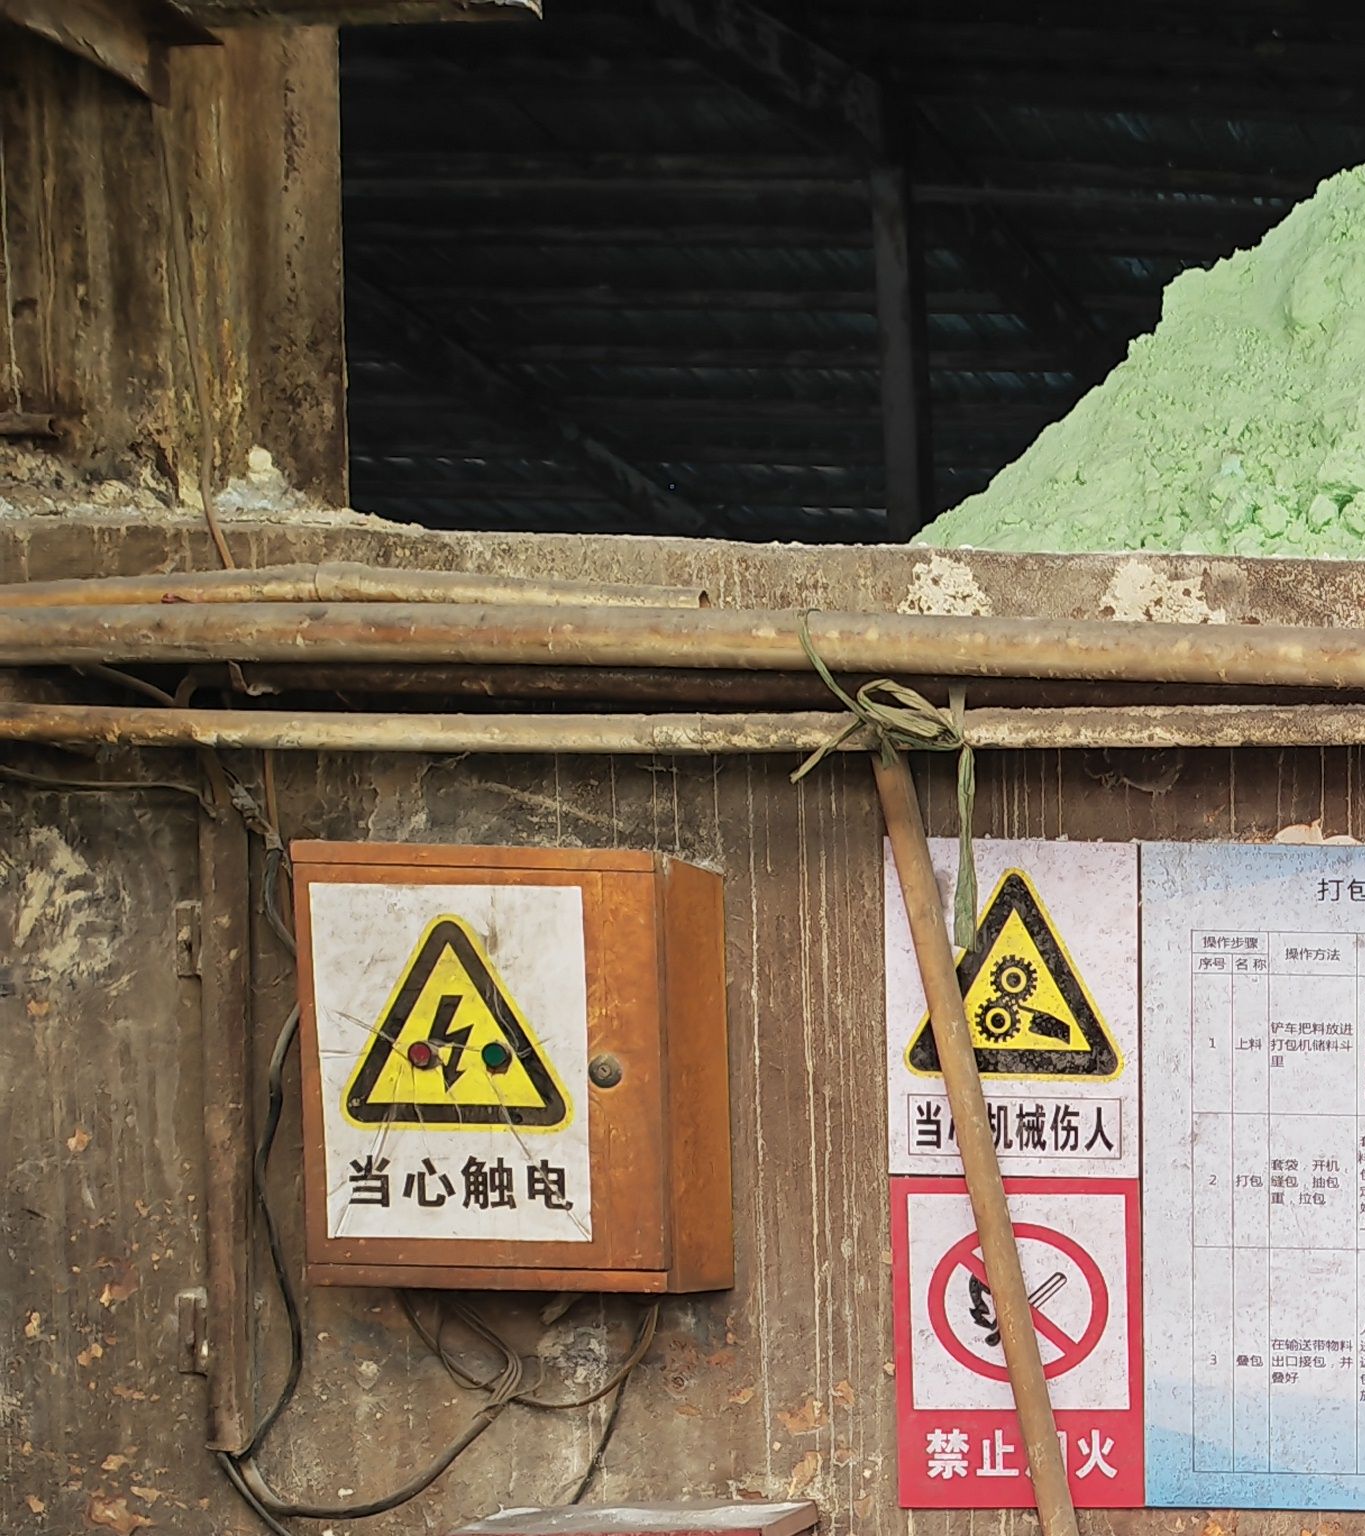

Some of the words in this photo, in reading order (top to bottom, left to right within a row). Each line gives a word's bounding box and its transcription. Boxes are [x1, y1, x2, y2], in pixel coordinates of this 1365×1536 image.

[1203, 936, 1258, 949] 操作步骤
[1285, 948, 1341, 961] 操作方法
[1199, 957, 1225, 970] 序号
[1271, 1022, 1353, 1036] 铲车把料放进
[1209, 1037, 1216, 1049] 1
[1235, 1037, 1262, 1050] 上料
[1271, 1039, 1353, 1052] 打包机储料斗
[1271, 1056, 1285, 1068] 里
[916, 1101, 1114, 1151] 当机械伤人
[349, 1155, 574, 1210] 当心触电
[1209, 1175, 1217, 1186] 2
[1236, 1174, 1263, 1188] 打包
[1271, 1338, 1353, 1351] 在输送带物料
[1209, 1355, 1217, 1366] 3
[1236, 1355, 1263, 1368] 叠包
[1271, 1371, 1299, 1384] 叠好
[926, 1428, 1118, 1480] 禁止火
